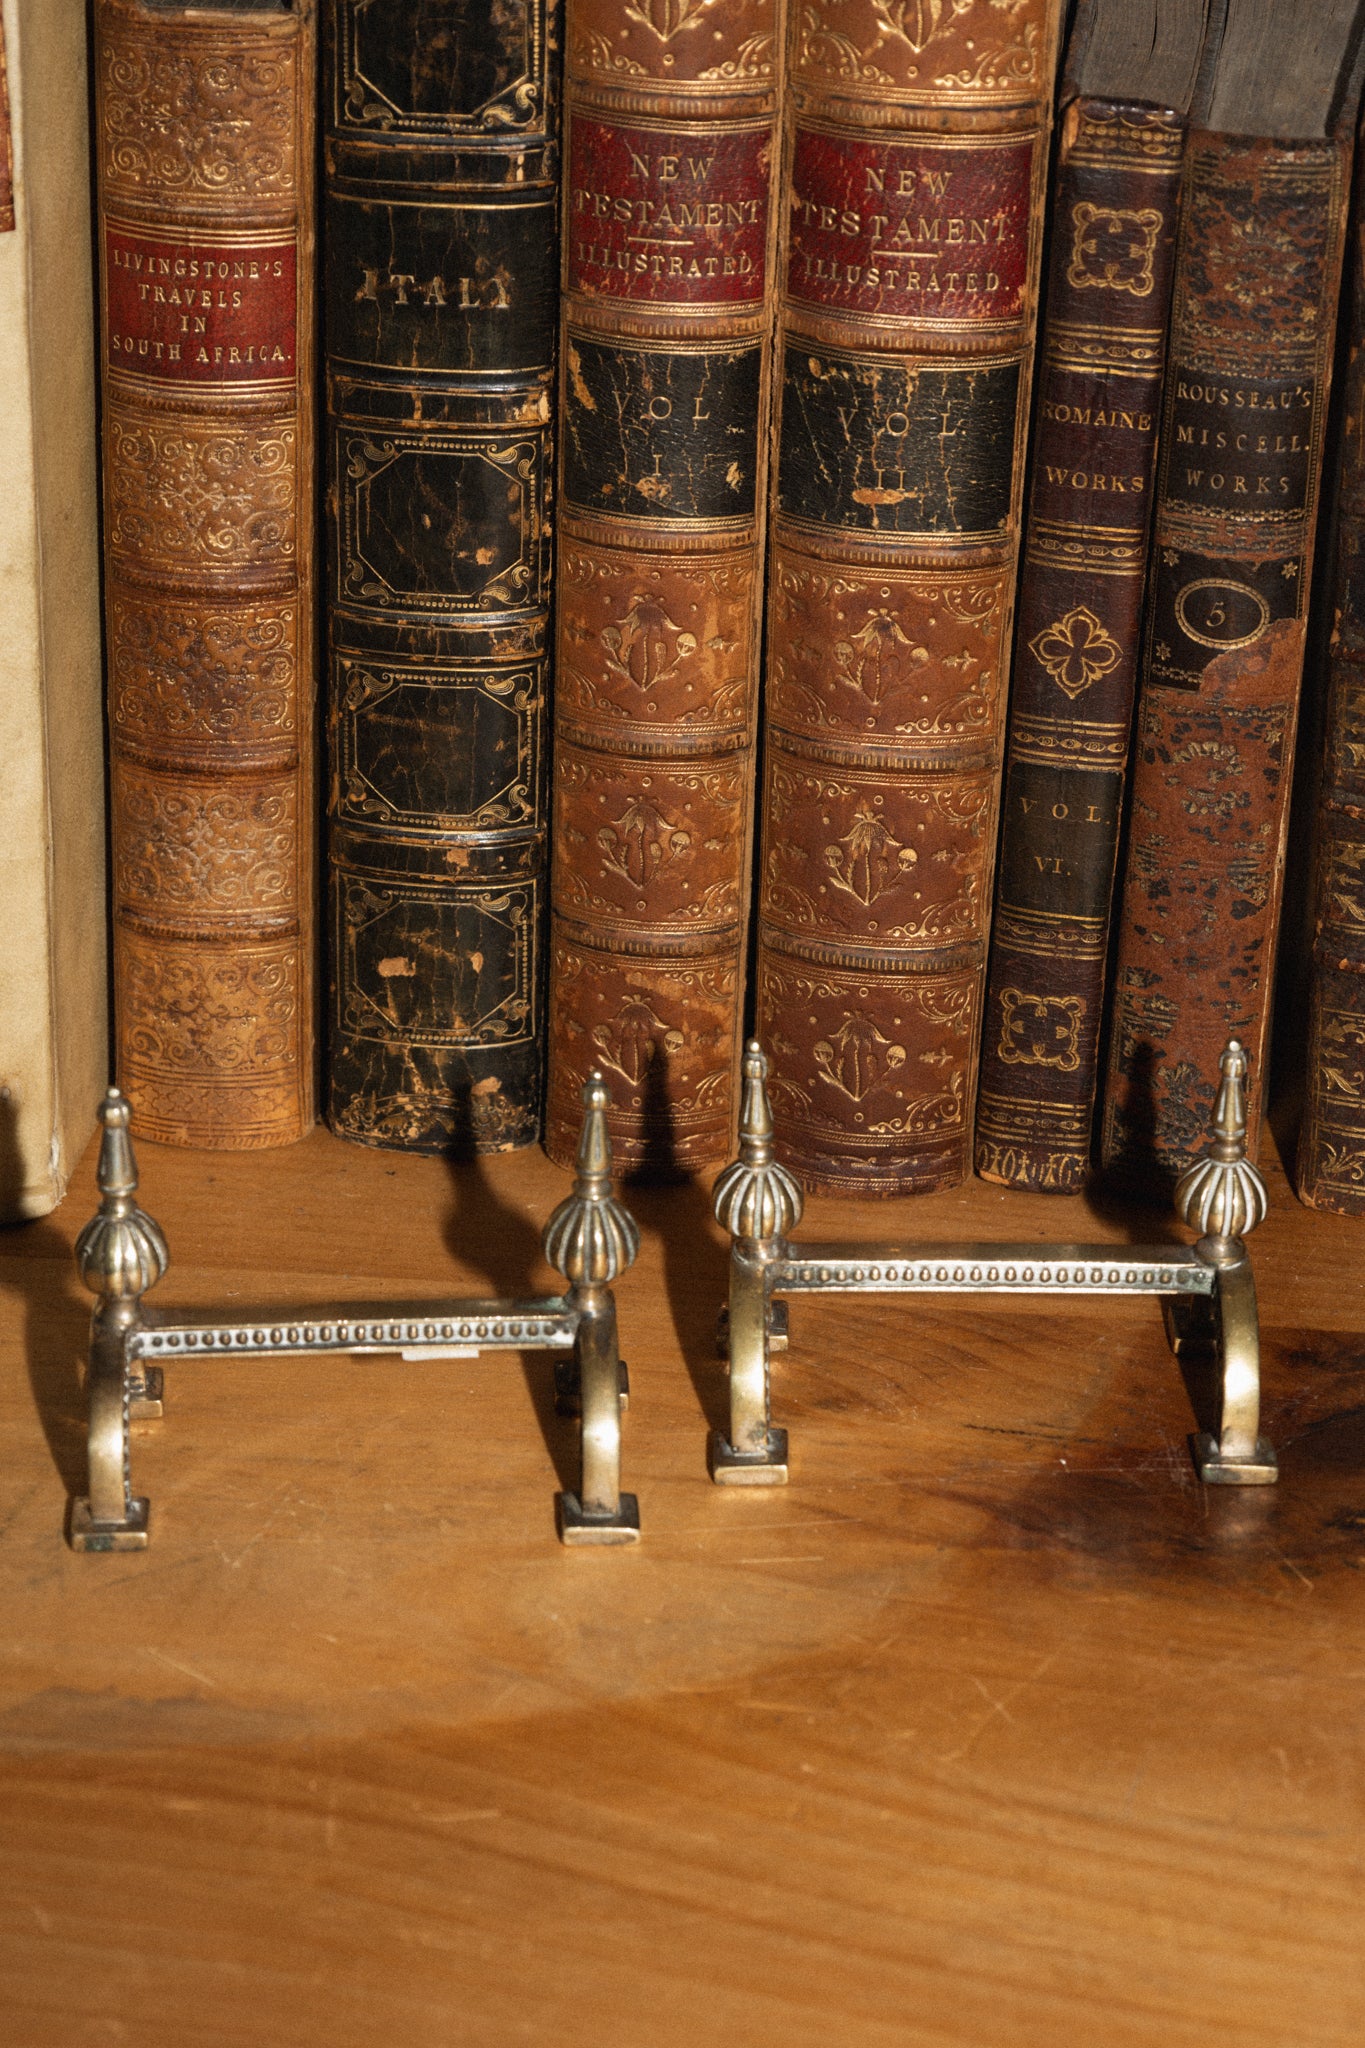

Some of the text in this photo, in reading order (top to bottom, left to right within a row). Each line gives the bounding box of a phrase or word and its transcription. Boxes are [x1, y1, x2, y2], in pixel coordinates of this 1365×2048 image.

[630, 152, 715, 181] NEW
[865, 167, 953, 197] NEW
[574, 188, 763, 228] TESTAMENT
[113, 249, 284, 279] LIVINGSTONE'S
[138, 283, 243, 308] TRAVELS
[181, 315, 207, 333] IN
[112, 334, 292, 364] SOUTH AFRICA.
[1176, 381, 1312, 411] ROUSSEAU'S
[1176, 424, 1311, 454] MISCELL.
[1045, 465, 1145, 493] WORKS
[1185, 467, 1290, 494] WORKS
[1205, 601, 1226, 628] 5
[1020, 797, 1111, 825] VOL.
[1034, 855, 1072, 877] VI.
